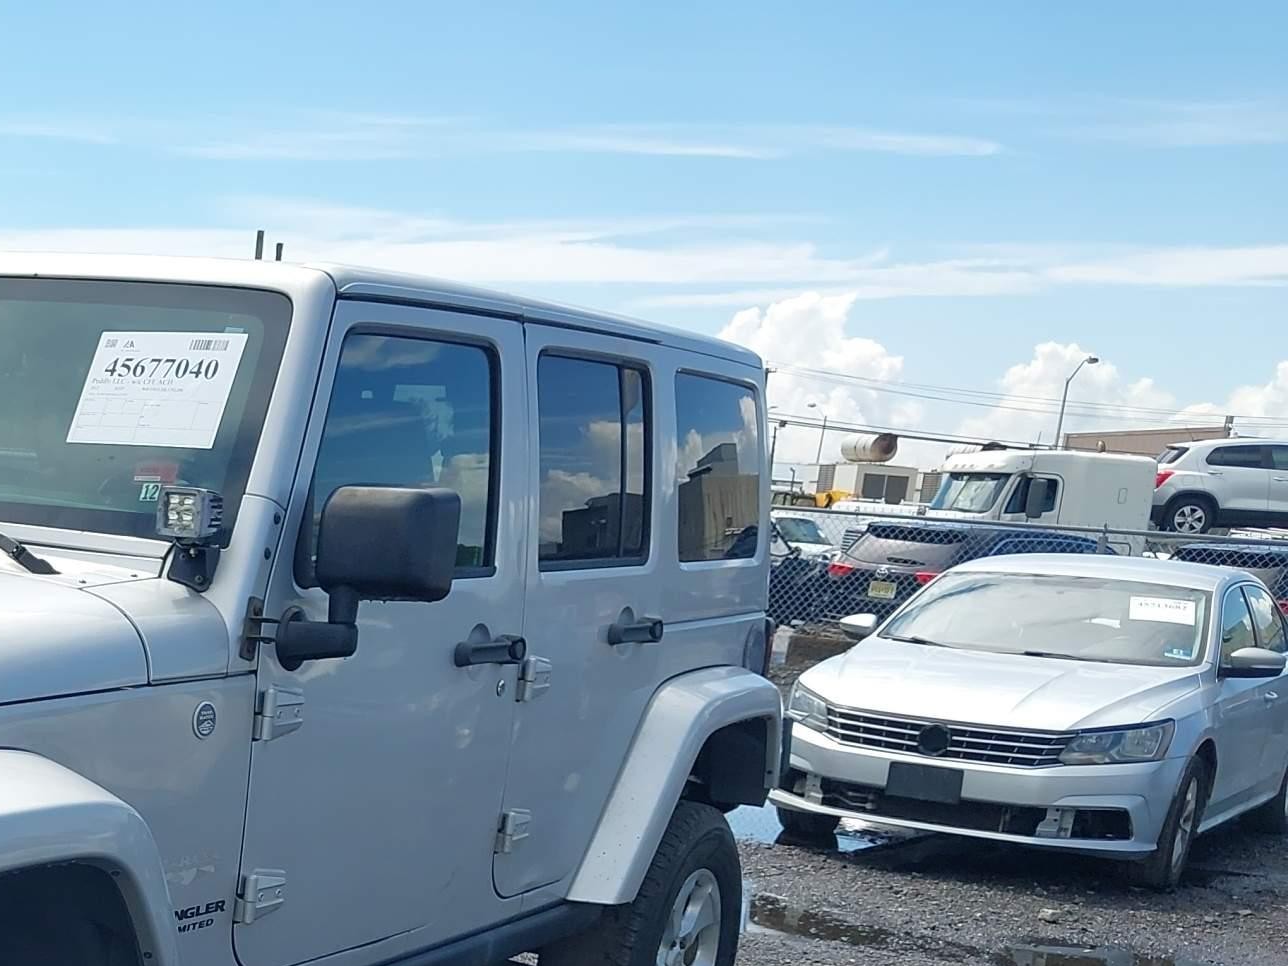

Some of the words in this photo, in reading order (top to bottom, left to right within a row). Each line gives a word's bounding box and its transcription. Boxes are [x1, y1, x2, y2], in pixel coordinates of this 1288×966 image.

[104, 356, 219, 380] 45677040
[142, 484, 159, 500] 12
[174, 900, 226, 921] NGLER
[177, 918, 214, 933] MITED
